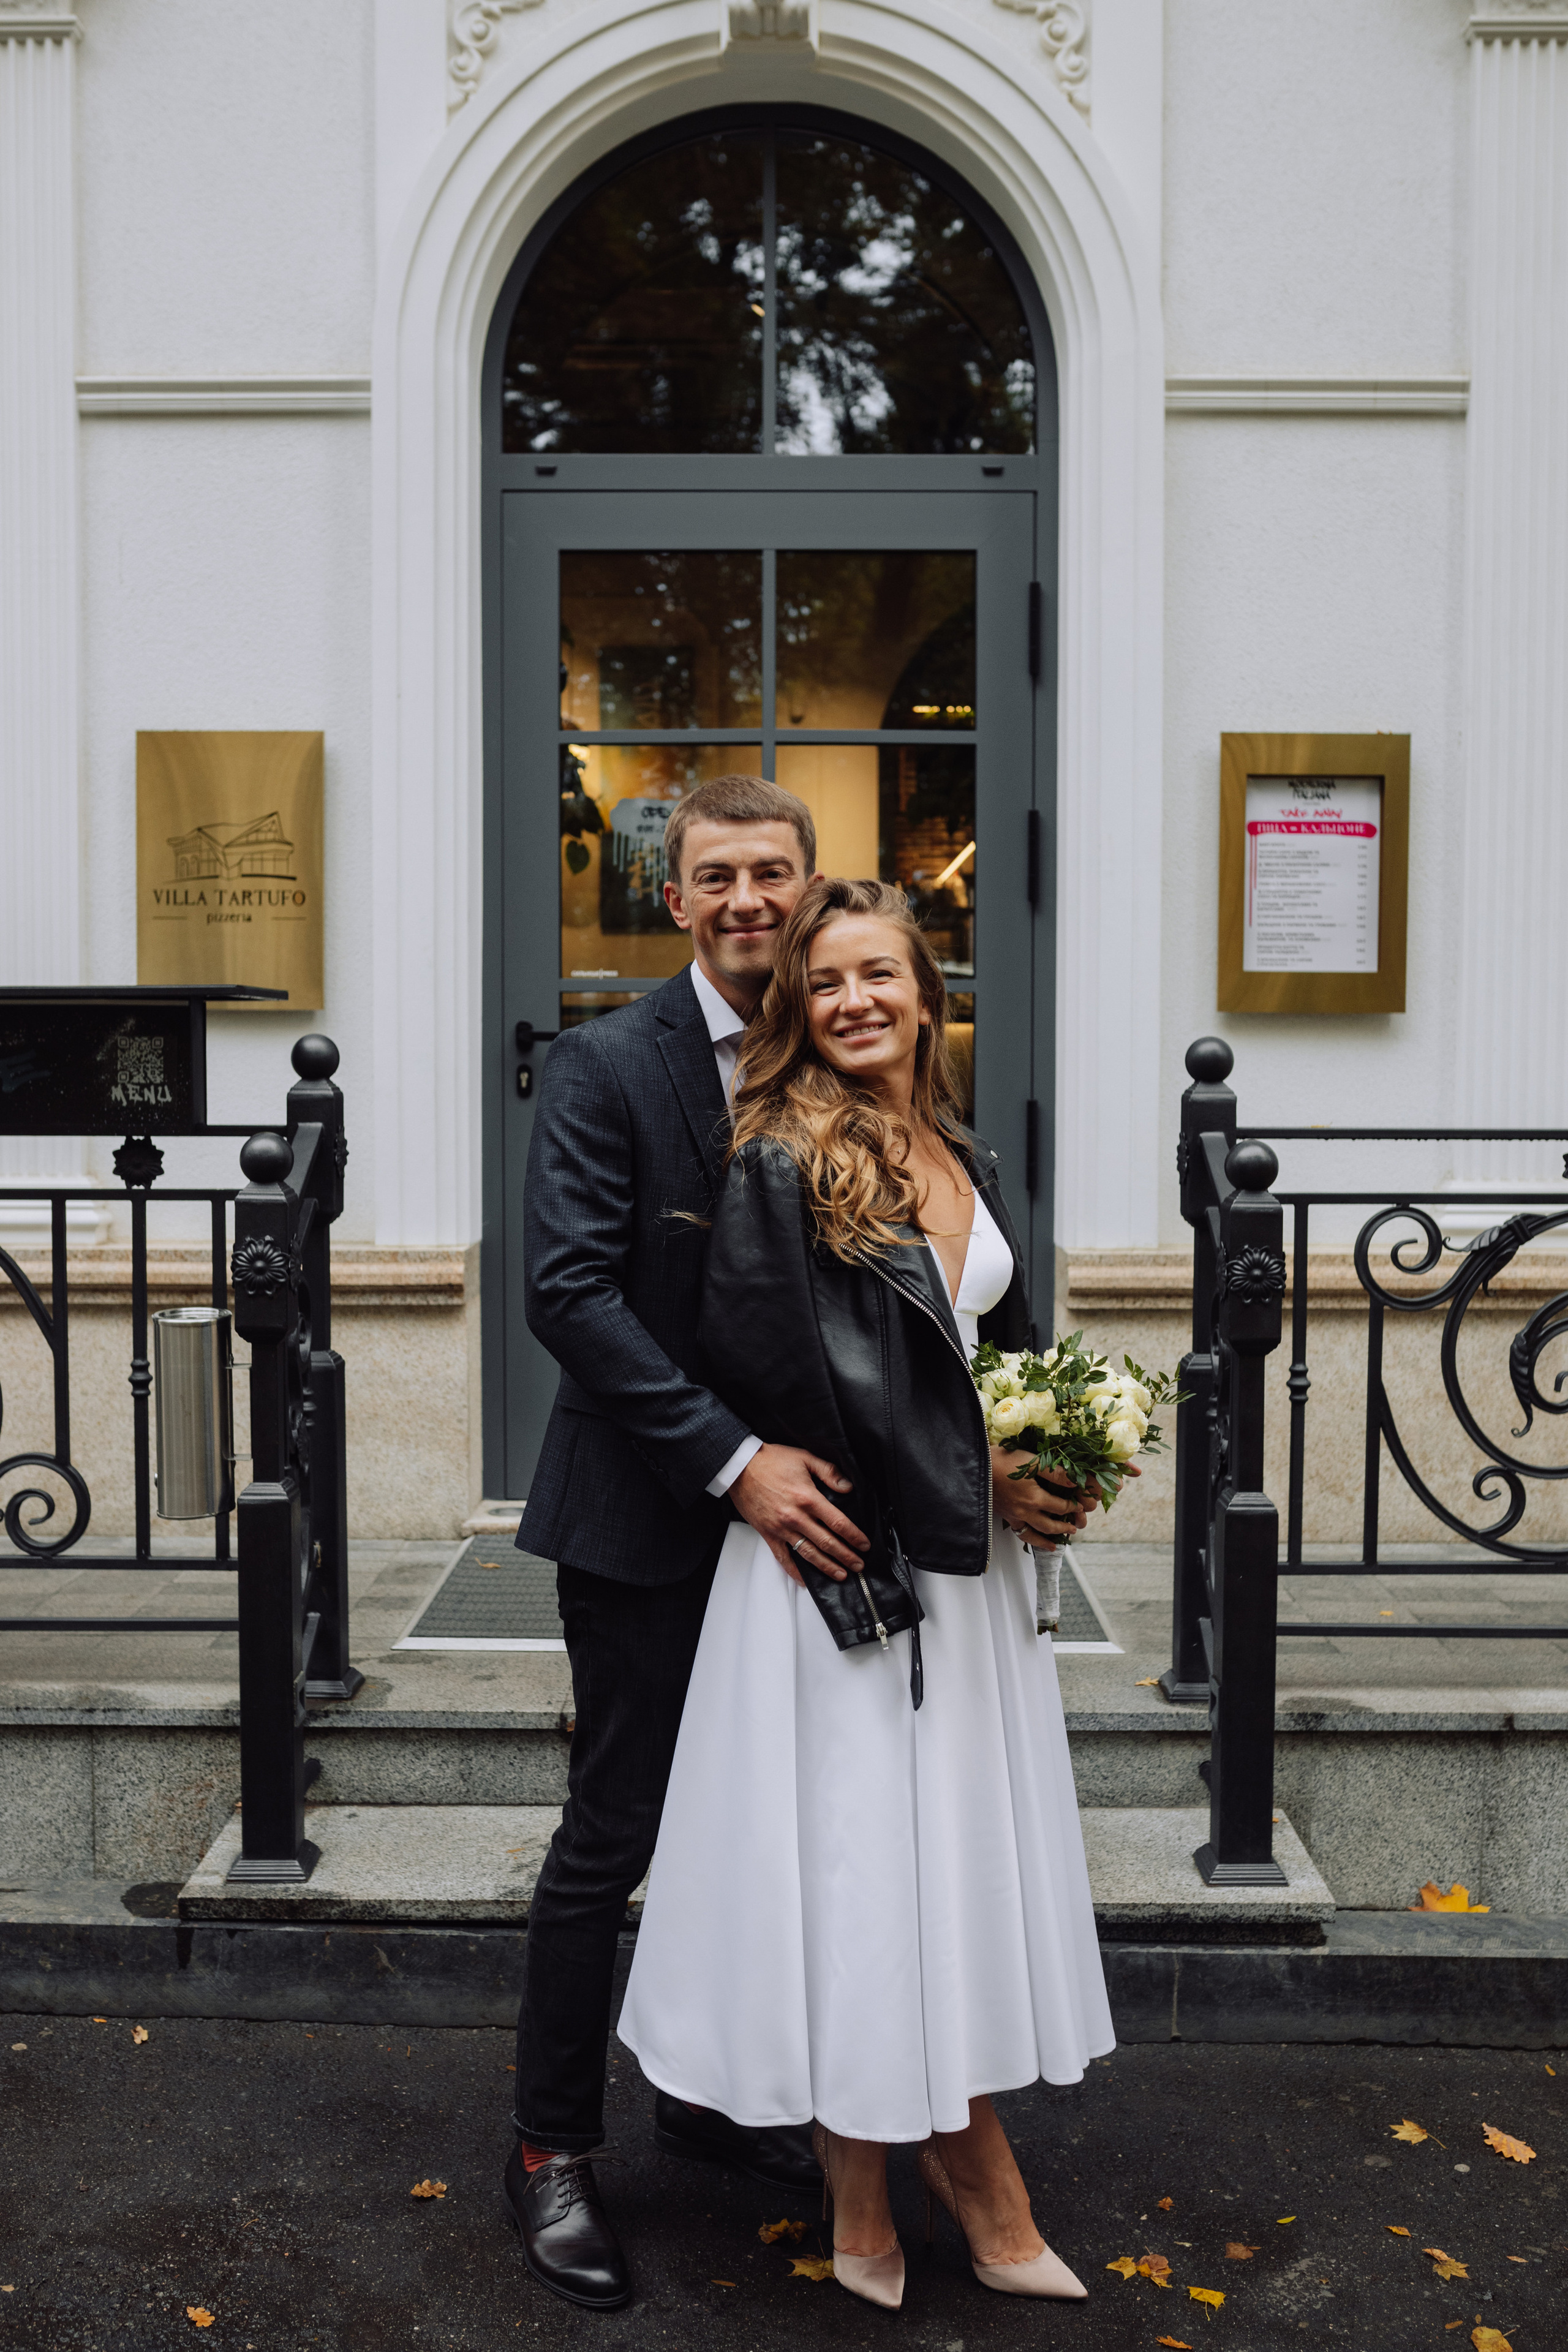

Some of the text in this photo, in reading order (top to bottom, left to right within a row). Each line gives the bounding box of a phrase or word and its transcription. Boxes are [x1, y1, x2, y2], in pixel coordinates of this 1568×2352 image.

[153, 889, 306, 907] VILLA TARTUFO
[206, 913, 252, 925] pizzeria
[111, 1083, 172, 1107] MENU
